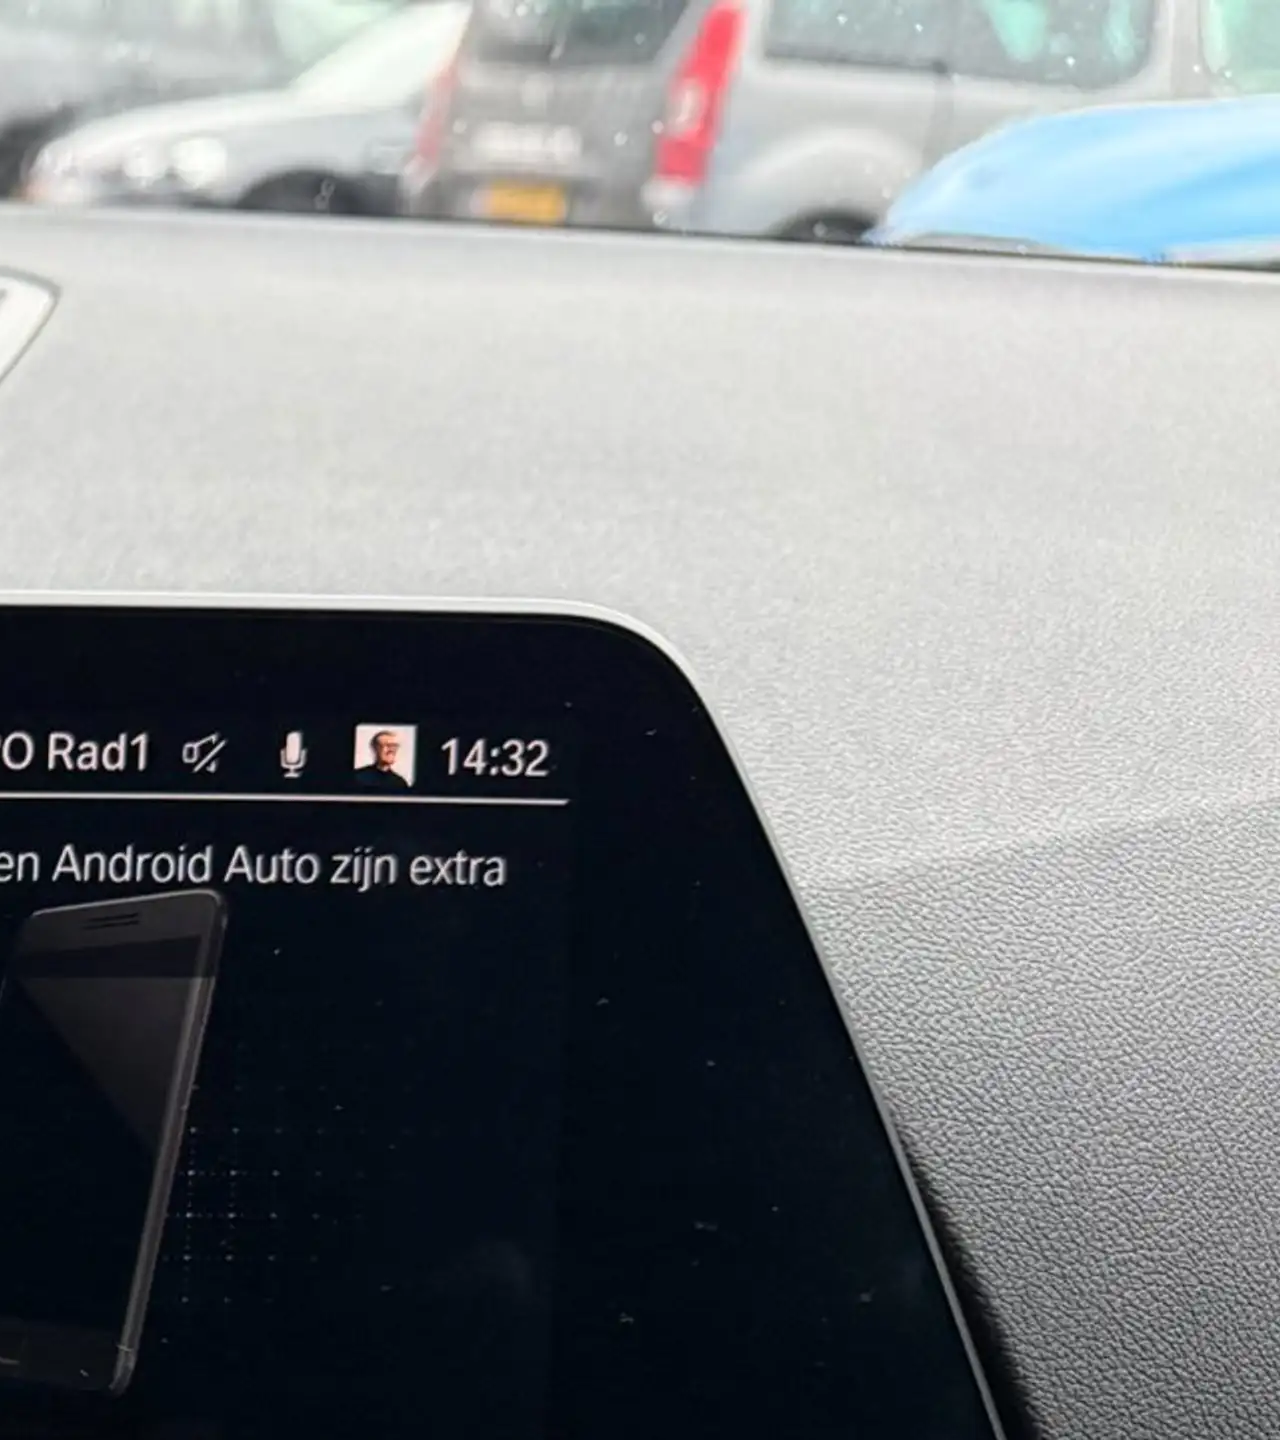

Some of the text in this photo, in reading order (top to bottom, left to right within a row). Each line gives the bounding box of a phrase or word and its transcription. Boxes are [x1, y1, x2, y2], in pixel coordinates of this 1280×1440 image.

[47, 732, 147, 771] Rad1
[441, 738, 548, 777] 14:32
[51, 844, 212, 883] Android
[223, 845, 320, 884] Auto
[330, 847, 397, 893] zijn
[409, 850, 505, 887] extra
